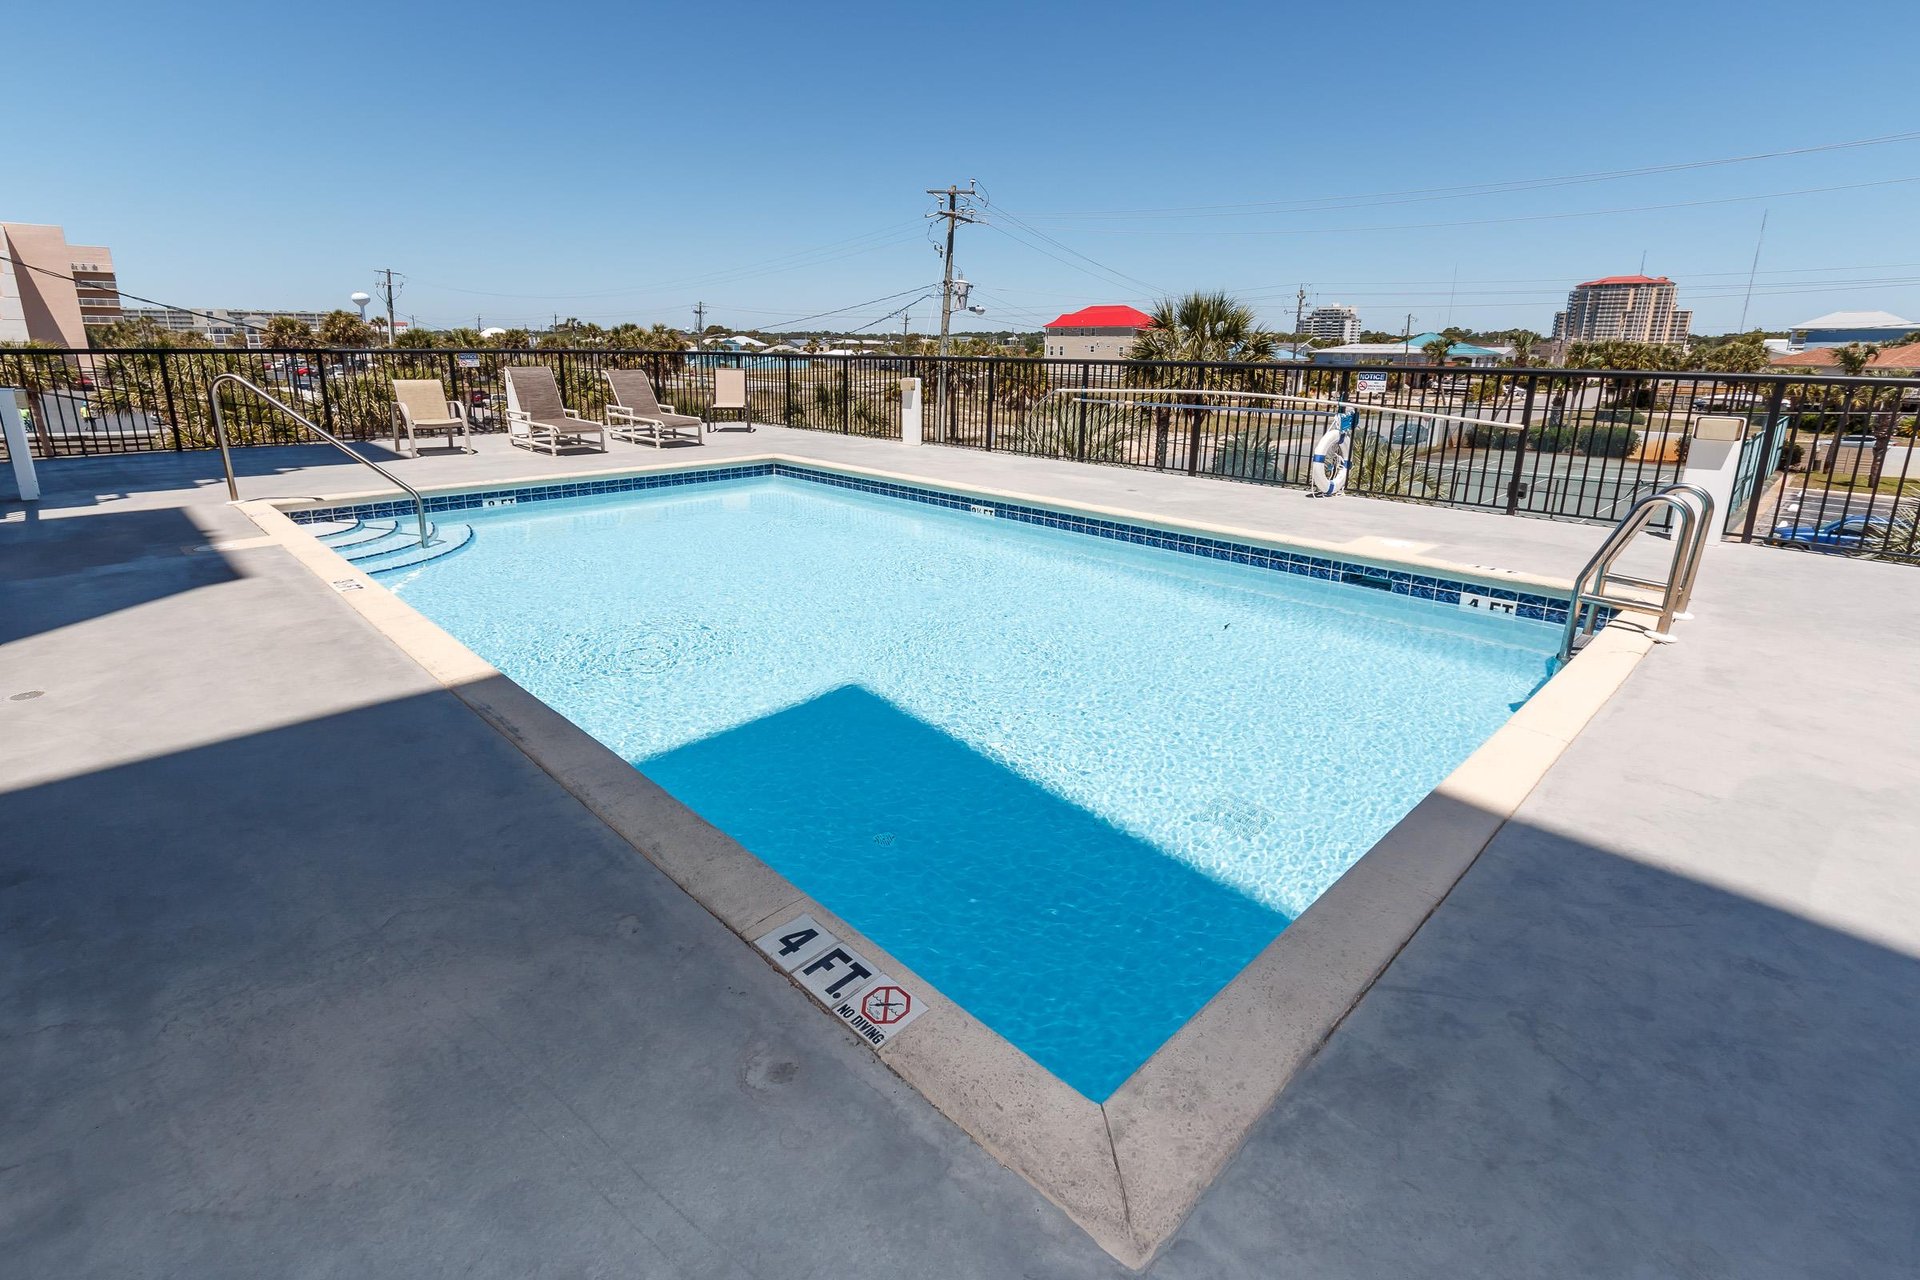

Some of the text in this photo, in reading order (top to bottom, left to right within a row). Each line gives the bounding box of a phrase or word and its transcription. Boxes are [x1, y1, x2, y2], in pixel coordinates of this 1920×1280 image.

[778, 928, 872, 999] 4 FT.
[837, 1004, 885, 1046] NO DIVING
